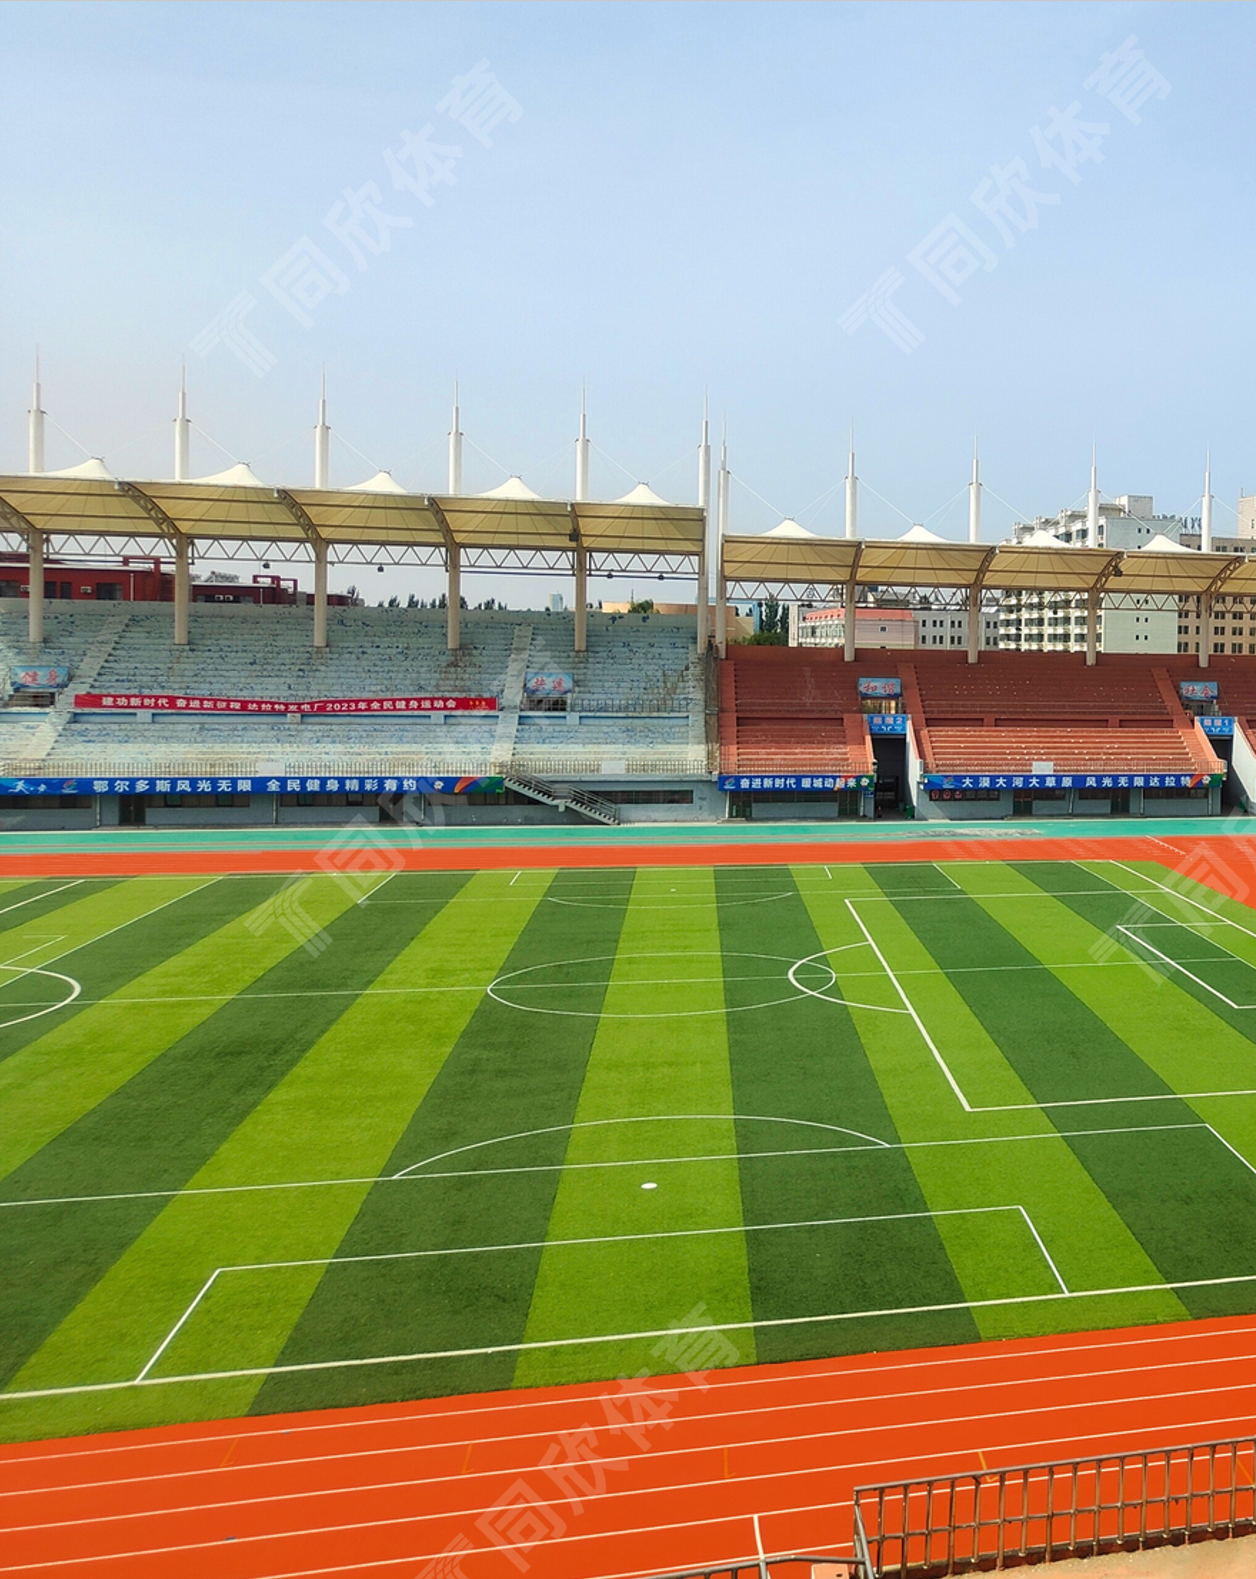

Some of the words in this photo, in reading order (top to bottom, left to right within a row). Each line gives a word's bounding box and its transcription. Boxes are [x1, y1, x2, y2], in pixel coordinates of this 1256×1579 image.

[20, 670, 61, 687] 健身
[863, 680, 896, 695] 和谐
[1184, 684, 1215, 698] 社会
[102, 696, 169, 707] 建功新时代
[175, 699, 242, 710] 奋进新征程
[247, 699, 457, 712] 达拉特发电厂2023年全民健身运动会
[93, 779, 252, 793] 鄂尔多斯风光无限
[266, 778, 417, 792] 全民健身精彩有约
[740, 778, 797, 789] 奋进新时代
[962, 776, 1073, 788] 大漠大河大草原
[1085, 776, 1191, 788] 风光无限达拉特
